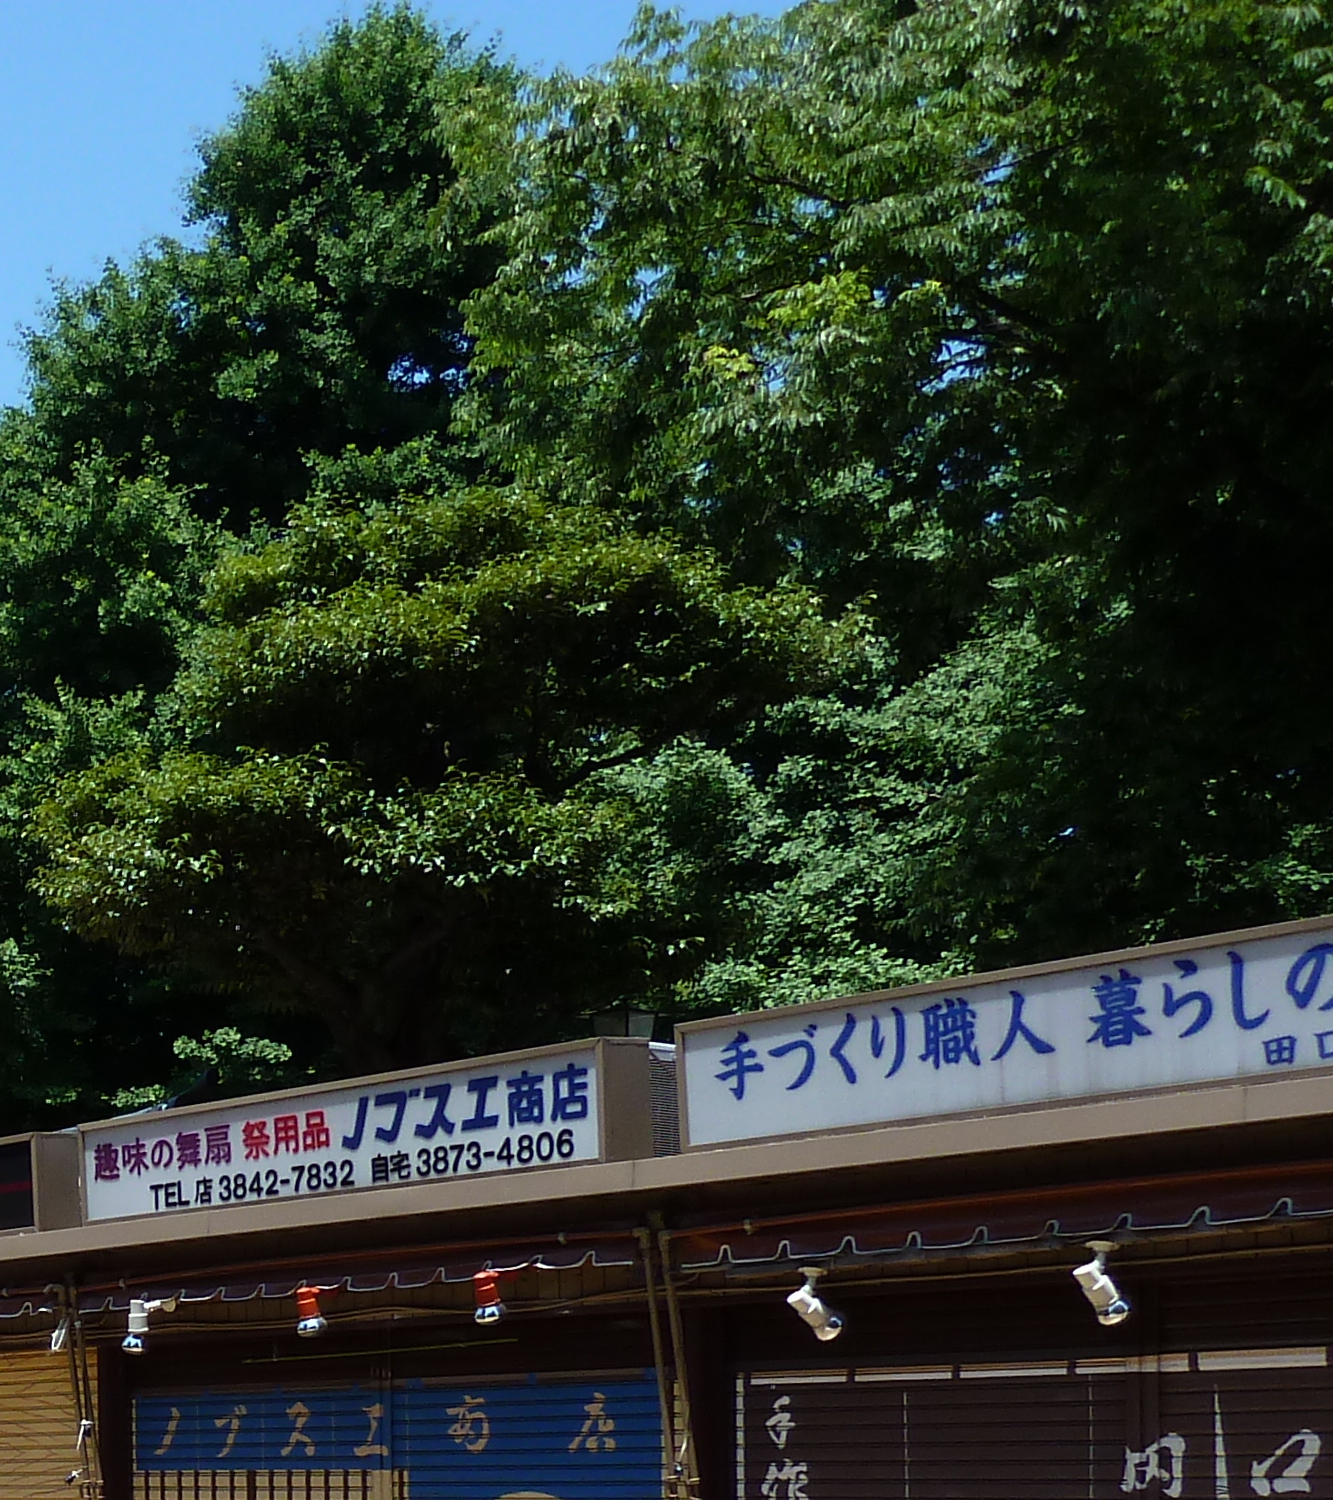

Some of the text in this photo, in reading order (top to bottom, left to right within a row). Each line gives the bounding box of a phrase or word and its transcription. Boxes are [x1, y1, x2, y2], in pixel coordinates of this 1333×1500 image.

[714, 990, 1055, 1102] 手づくり職人
[93, 1121, 233, 1184] 趣味の舞扇
[241, 1109, 331, 1158] 祭用品
[150, 1129, 575, 1210] TEL 店 3842-7832 自宅 3873-4806
